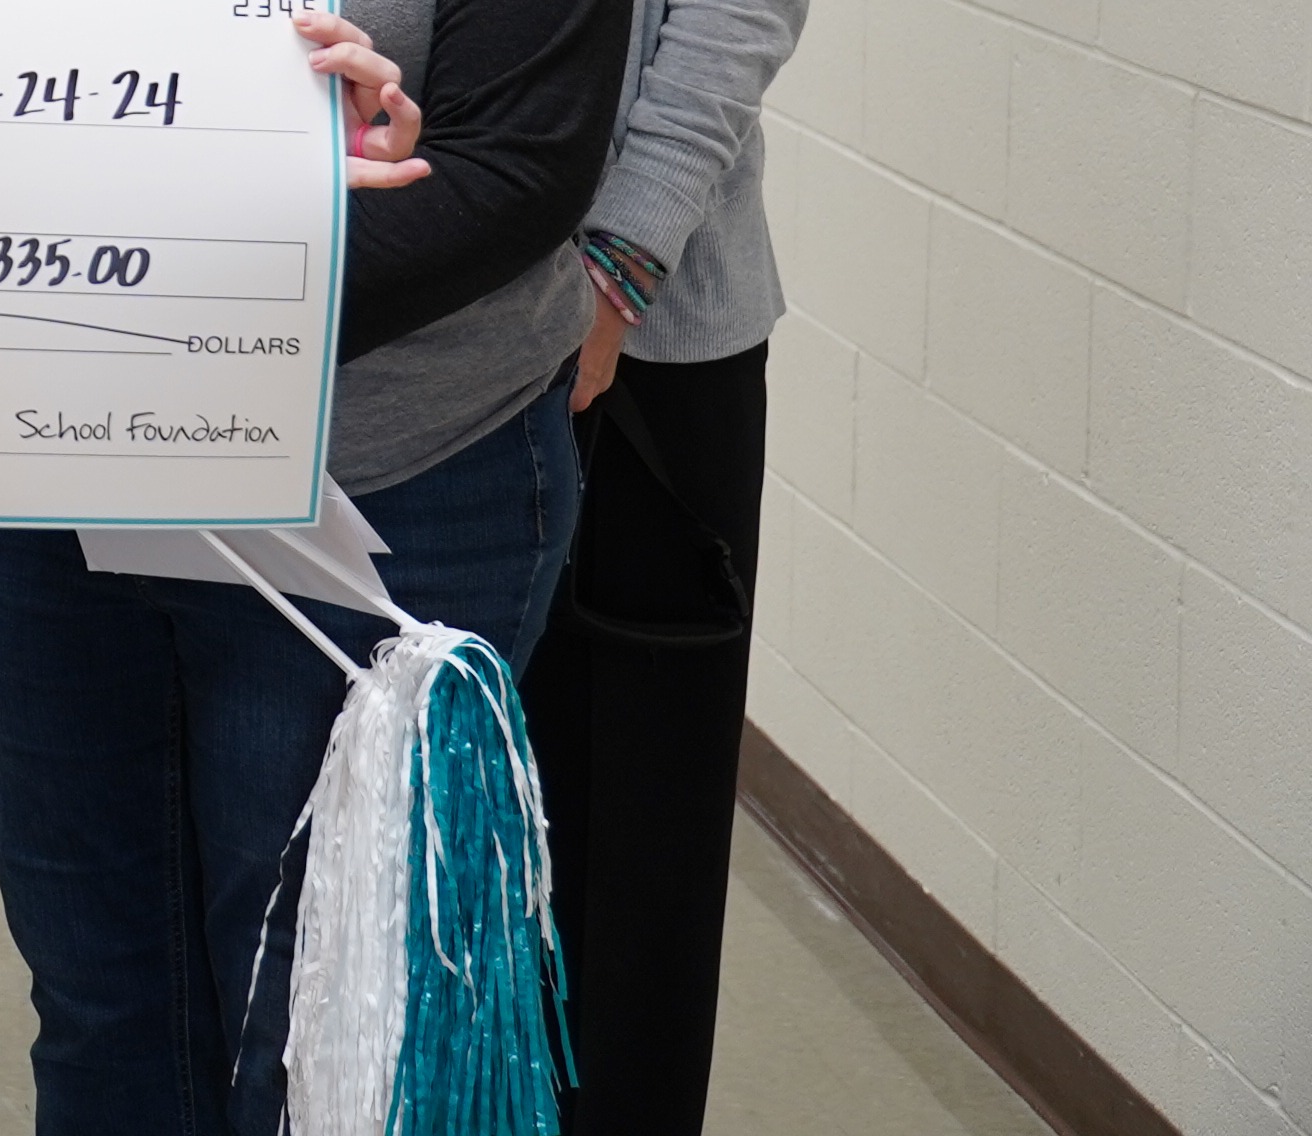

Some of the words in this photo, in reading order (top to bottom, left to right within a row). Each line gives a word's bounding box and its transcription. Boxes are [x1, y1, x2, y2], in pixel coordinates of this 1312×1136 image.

[187, 335, 301, 356] DOLLARS
[15, 410, 112, 442] School
[127, 413, 281, 444] Foundation
